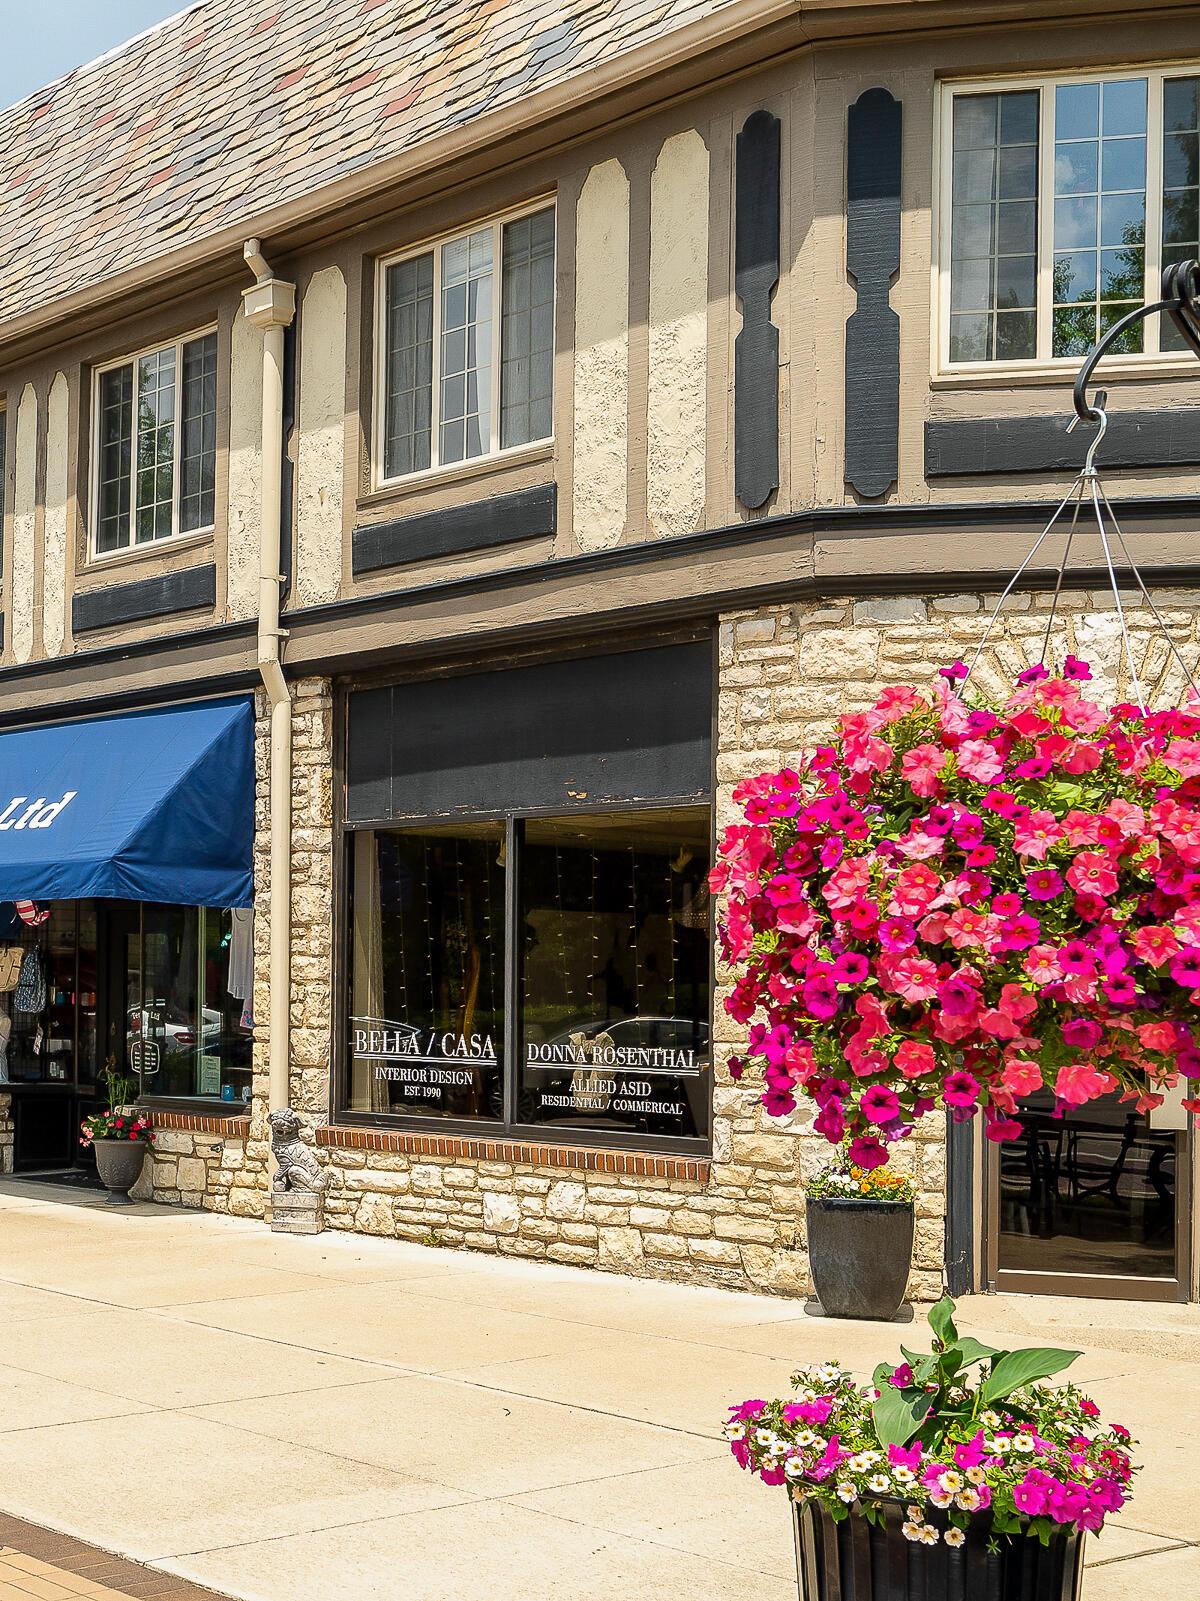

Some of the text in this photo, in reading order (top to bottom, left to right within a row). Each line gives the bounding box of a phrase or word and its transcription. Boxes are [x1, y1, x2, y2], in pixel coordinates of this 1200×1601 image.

[354, 1029, 421, 1055] BELLA
[441, 1032, 498, 1059] CASA
[527, 1043, 700, 1068] DONNA ROSENTHAL
[375, 1067, 474, 1085] INTERIOR DESIGN
[404, 1086, 442, 1098] EST. 1990
[568, 1079, 652, 1096] ALLIED ASID
[541, 1094, 605, 1109] RESIDENTIAL
[613, 1099, 683, 1115] COMMERICAL
